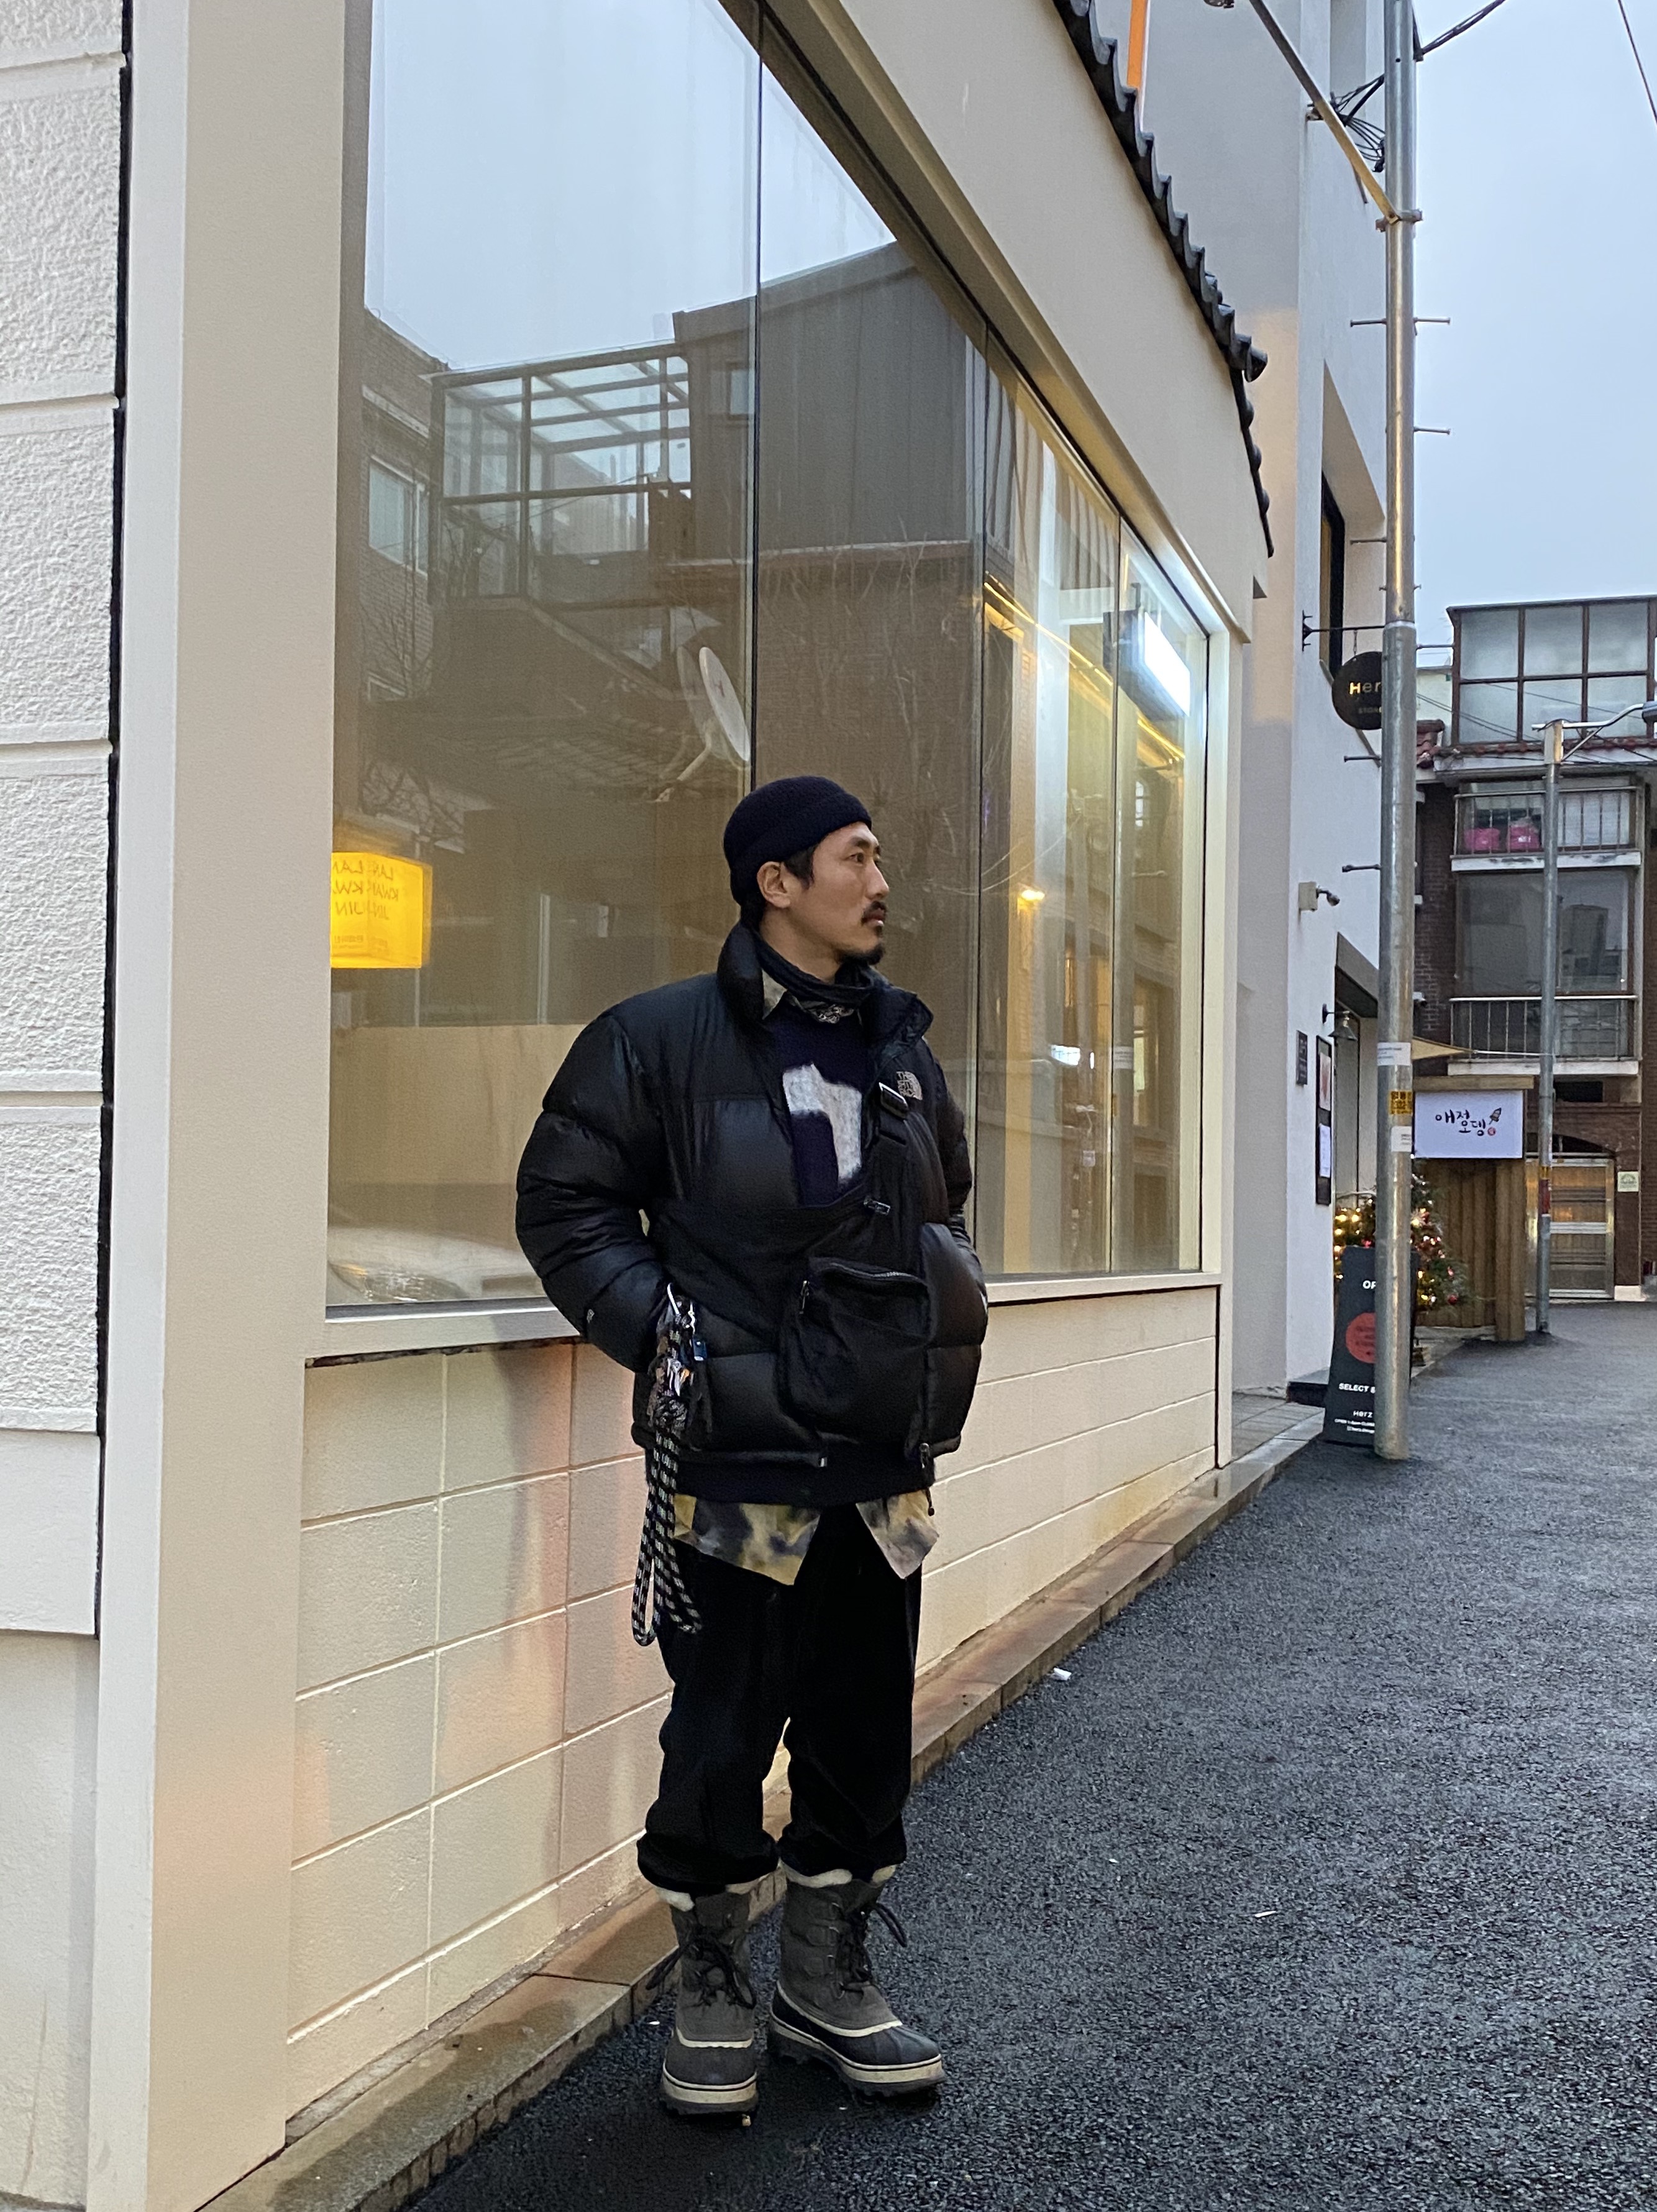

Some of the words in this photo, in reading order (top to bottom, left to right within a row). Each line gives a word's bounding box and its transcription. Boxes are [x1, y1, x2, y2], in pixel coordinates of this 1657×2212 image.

[1349, 682, 1381, 695] Her
[1363, 1280, 1376, 1289] OP
[1338, 1382, 1369, 1392] SELECT
